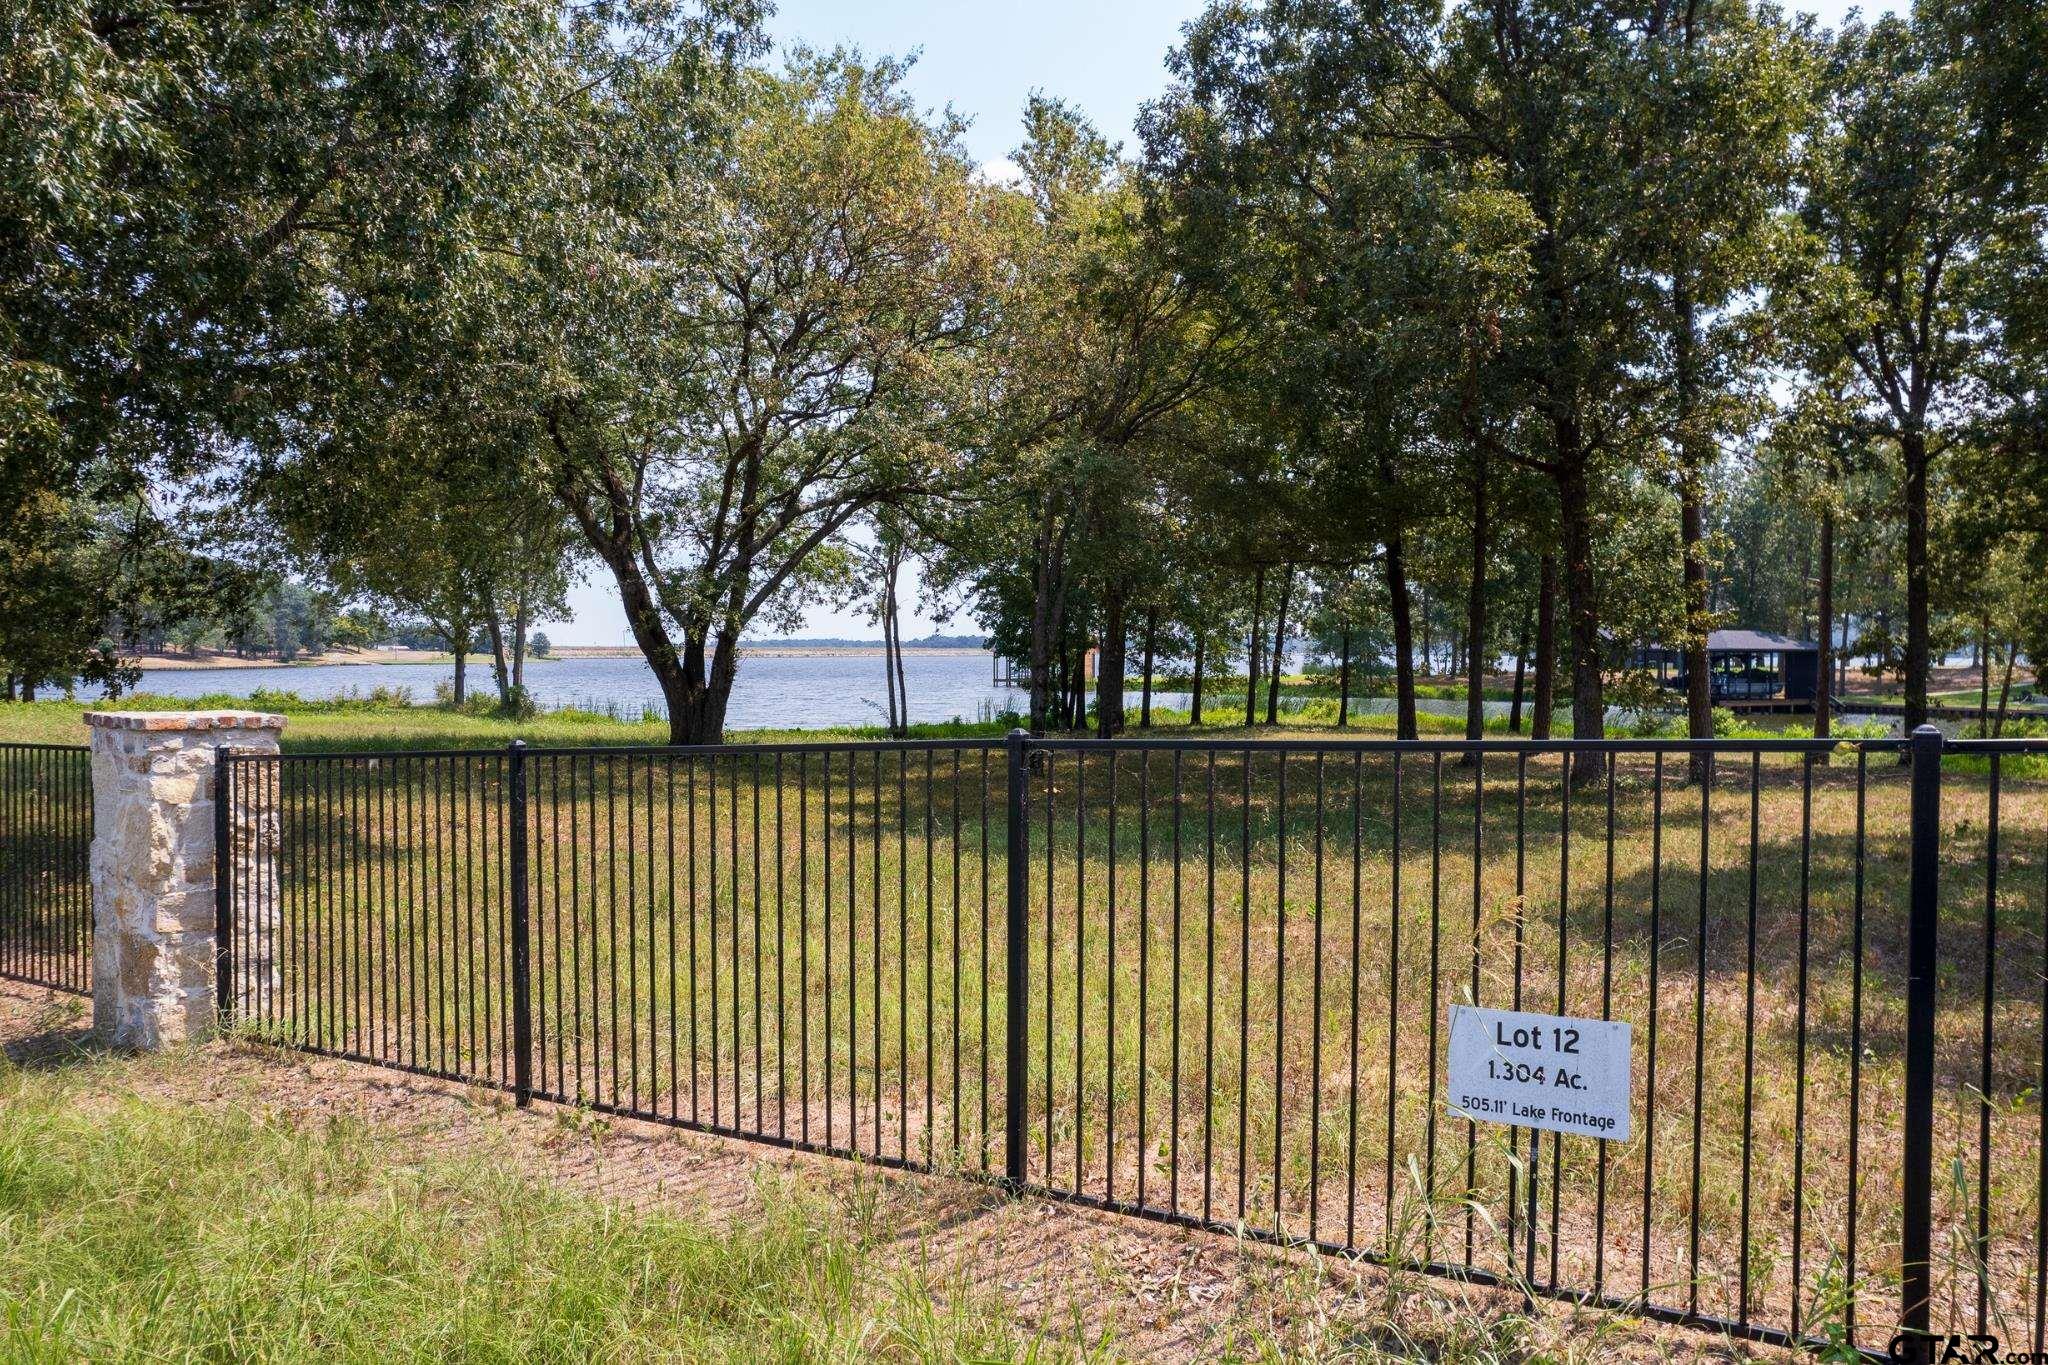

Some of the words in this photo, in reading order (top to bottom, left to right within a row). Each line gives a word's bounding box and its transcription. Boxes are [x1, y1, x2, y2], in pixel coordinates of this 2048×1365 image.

[1496, 1021, 1542, 1050] Lot
[1553, 1028, 1580, 1054] 12
[1488, 1059, 1546, 1085] 1.304
[1554, 1068, 1588, 1091] Ac.
[1462, 1095, 1507, 1114] 505.11'
[1512, 1102, 1546, 1119] Lake
[1551, 1108, 1616, 1131] Frontage
